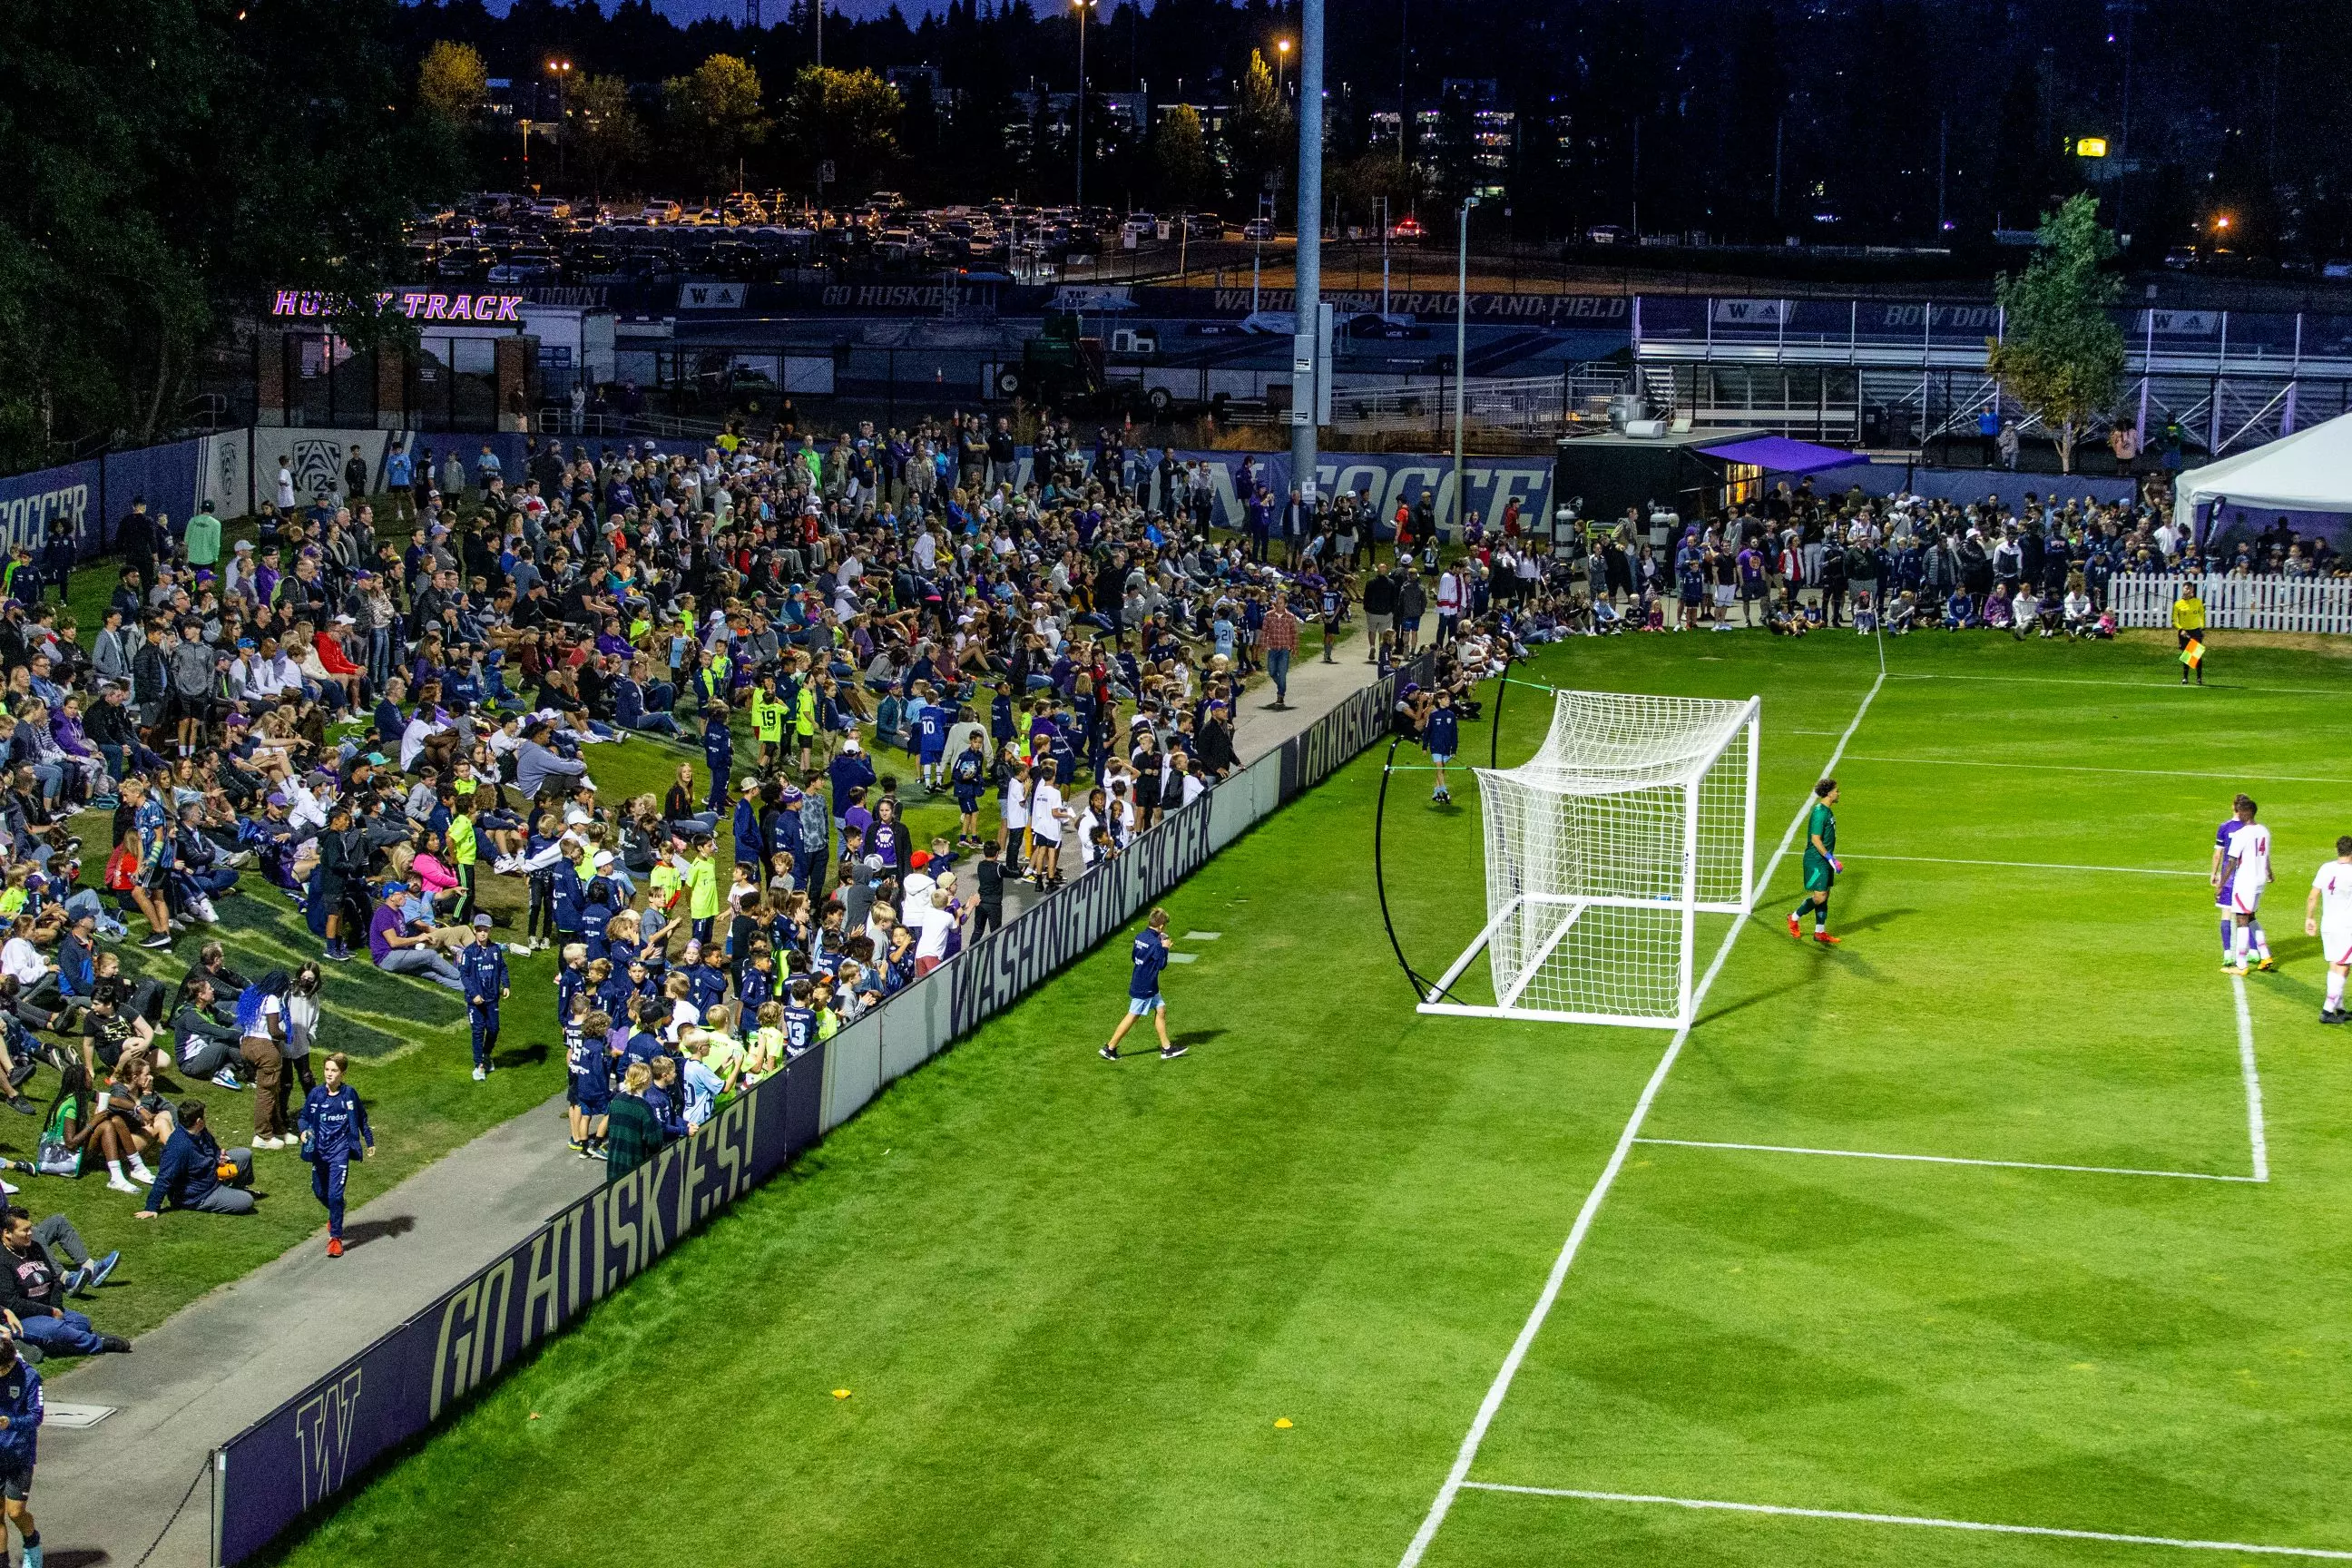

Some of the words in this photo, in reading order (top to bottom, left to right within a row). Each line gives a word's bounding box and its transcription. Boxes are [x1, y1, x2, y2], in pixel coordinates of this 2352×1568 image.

[272, 289, 393, 317] HUY
[404, 293, 524, 321] TRACK
[691, 288, 709, 304] W
[821, 285, 853, 306] GO
[857, 285, 974, 307] HUSKIES!
[1389, 293, 1481, 316] TRACK
[1484, 296, 1544, 317] AND
[1549, 296, 1627, 318] FIELD
[1728, 303, 1749, 319] W
[1884, 304, 1945, 327] BOW
[1221, 629, 1231, 642] 21
[762, 710, 777, 727] 19
[921, 720, 936, 735] 10
[2255, 837, 2266, 858] 14
[2328, 876, 2337, 896] 4
[950, 846, 1132, 1040] WASHINGTON
[1135, 789, 1214, 906] SOCCER
[787, 1021, 806, 1046] 13
[430, 1257, 514, 1422] GO
[522, 1089, 758, 1349] HUSKIES!
[296, 1367, 362, 1513] W
